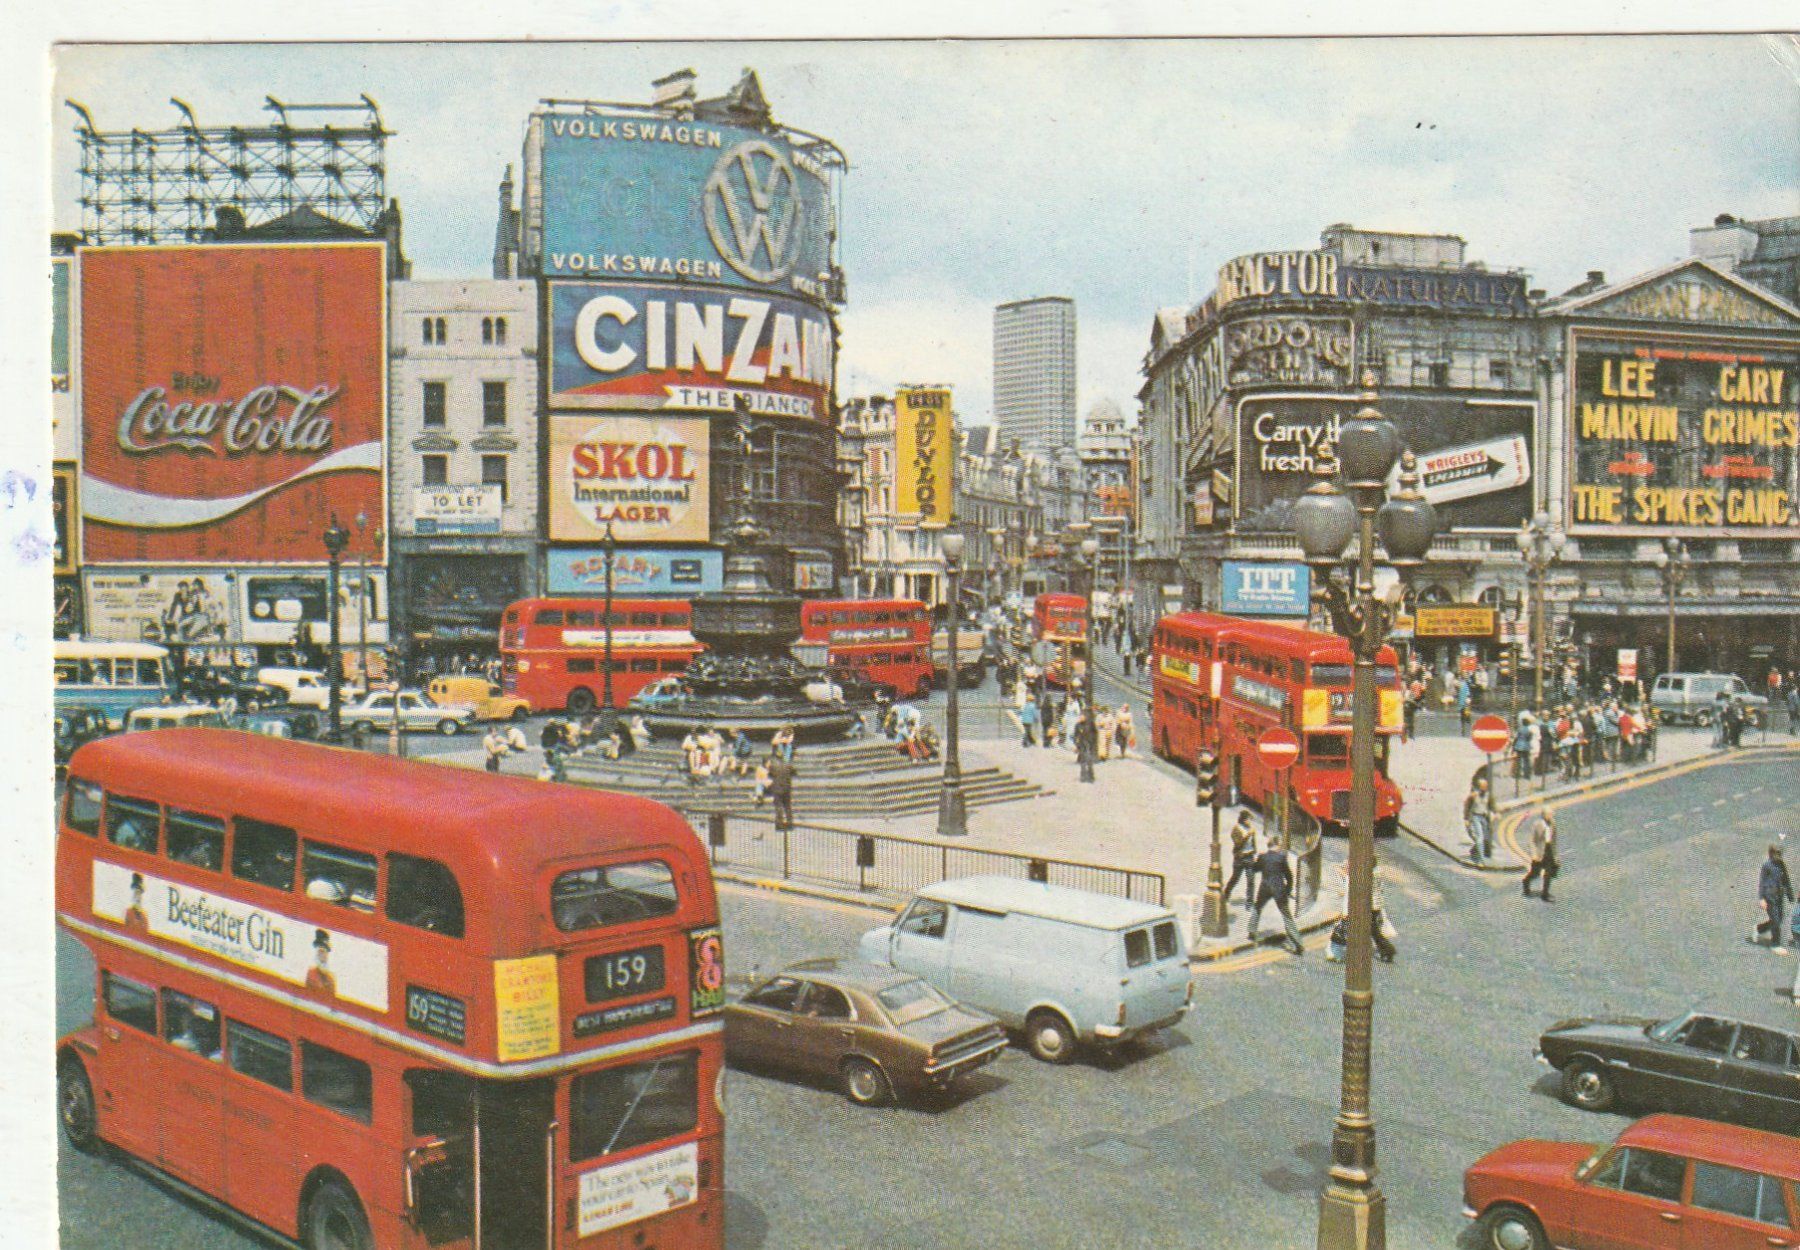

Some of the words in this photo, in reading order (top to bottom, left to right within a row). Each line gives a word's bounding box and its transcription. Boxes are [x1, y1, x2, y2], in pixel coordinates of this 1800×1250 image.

[551, 118, 721, 148] VOLKSWAGEN
[551, 253, 722, 279] VOLKSWAGEN
[1346, 274, 1519, 305] NATURALLY
[1601, 359, 1656, 398] LEE
[679, 388, 729, 407] THE
[117, 384, 340, 454] Coca-Cola
[1254, 413, 1321, 447] Carry
[1581, 402, 1679, 441] MARVIN
[571, 440, 696, 482] SKOL
[1260, 445, 1314, 473] fresh
[432, 496, 449, 507] TO
[458, 496, 482, 507] LET
[572, 482, 691, 503] International
[1573, 486, 1624, 523] THE
[1634, 487, 1721, 524] SPIKES
[594, 506, 672, 522] LAGER
[1237, 567, 1296, 594] ITT
[166, 885, 243, 945] Beefeater
[246, 912, 285, 959] Gin
[606, 954, 648, 989] 159
